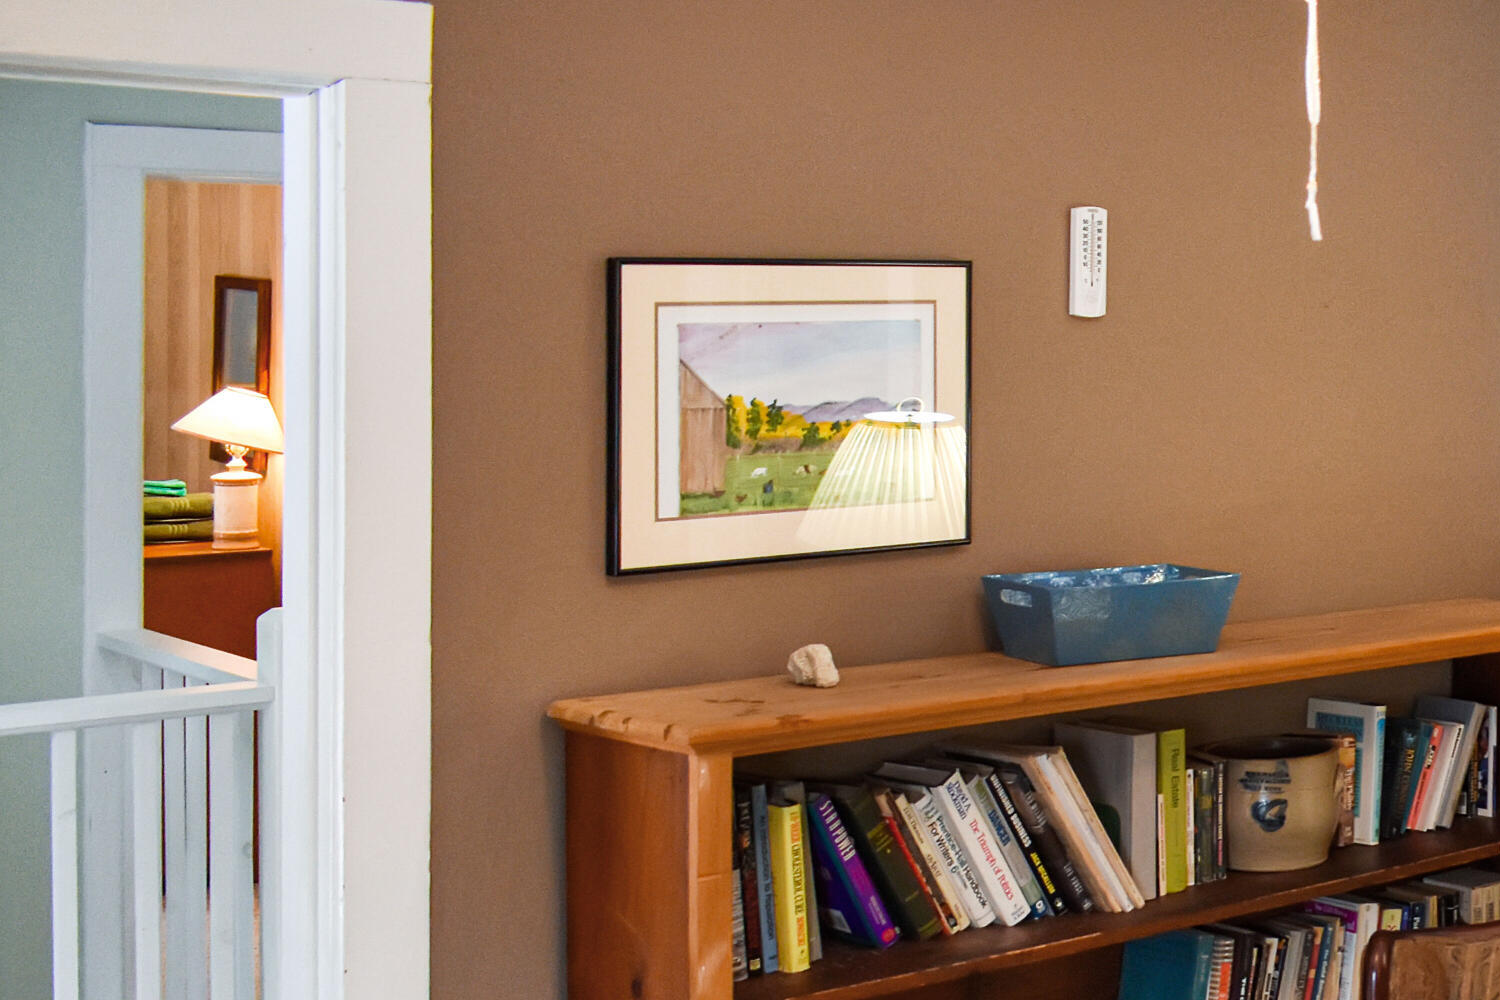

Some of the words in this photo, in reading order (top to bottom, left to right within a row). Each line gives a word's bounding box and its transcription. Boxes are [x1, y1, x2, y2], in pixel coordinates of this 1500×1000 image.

[1171, 748, 1179, 772] Real
[1170, 775, 1179, 808] Estate
[969, 818, 979, 833] The
[990, 773, 1014, 815] UNFINISHED
[1010, 813, 1032, 848] BUSINESS
[927, 821, 939, 838] For
[936, 834, 954, 867] Writers
[976, 832, 997, 868] Triumph
[992, 864, 1001, 876] of
[996, 872, 1014, 901] Politics
[963, 865, 987, 909] Handbook
